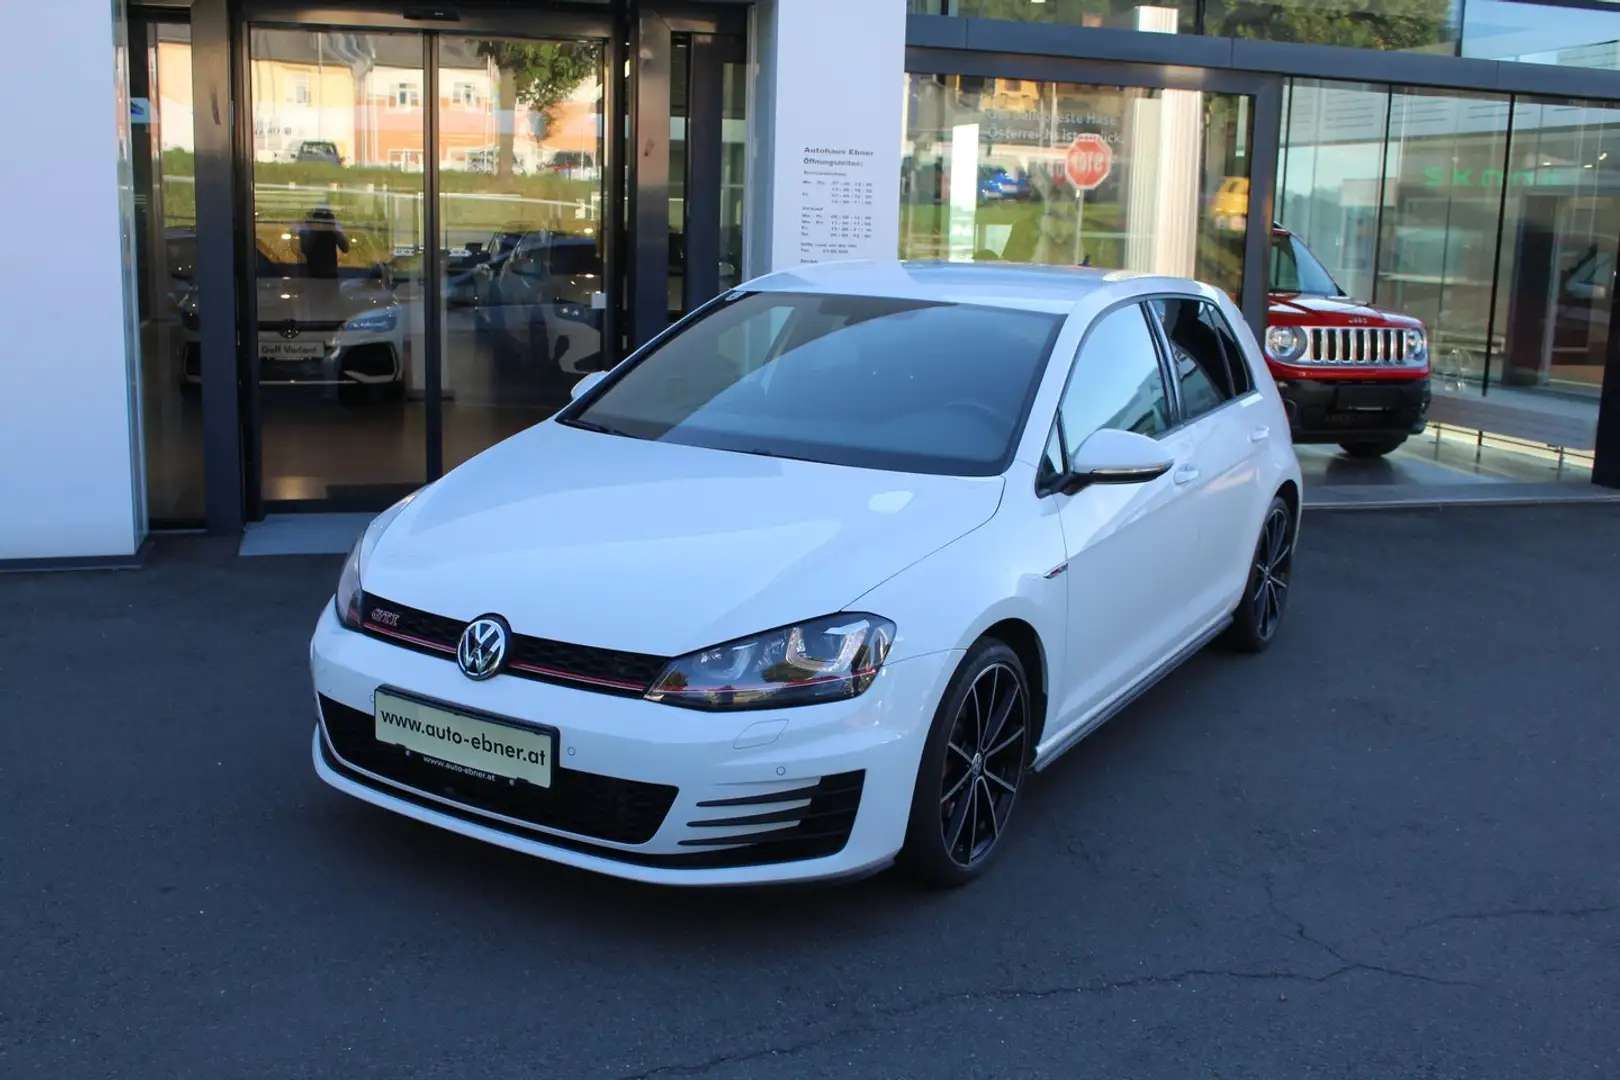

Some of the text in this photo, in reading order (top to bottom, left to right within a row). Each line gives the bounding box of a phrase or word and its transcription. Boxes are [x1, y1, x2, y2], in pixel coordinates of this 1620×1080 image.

[804, 146, 874, 156] Autohaus Ebner
[261, 344, 317, 354] Golf Variant
[371, 608, 400, 626] GTI
[380, 709, 546, 766] www.auto-ebner.at
[423, 755, 496, 782] www.auto-ebner.at
